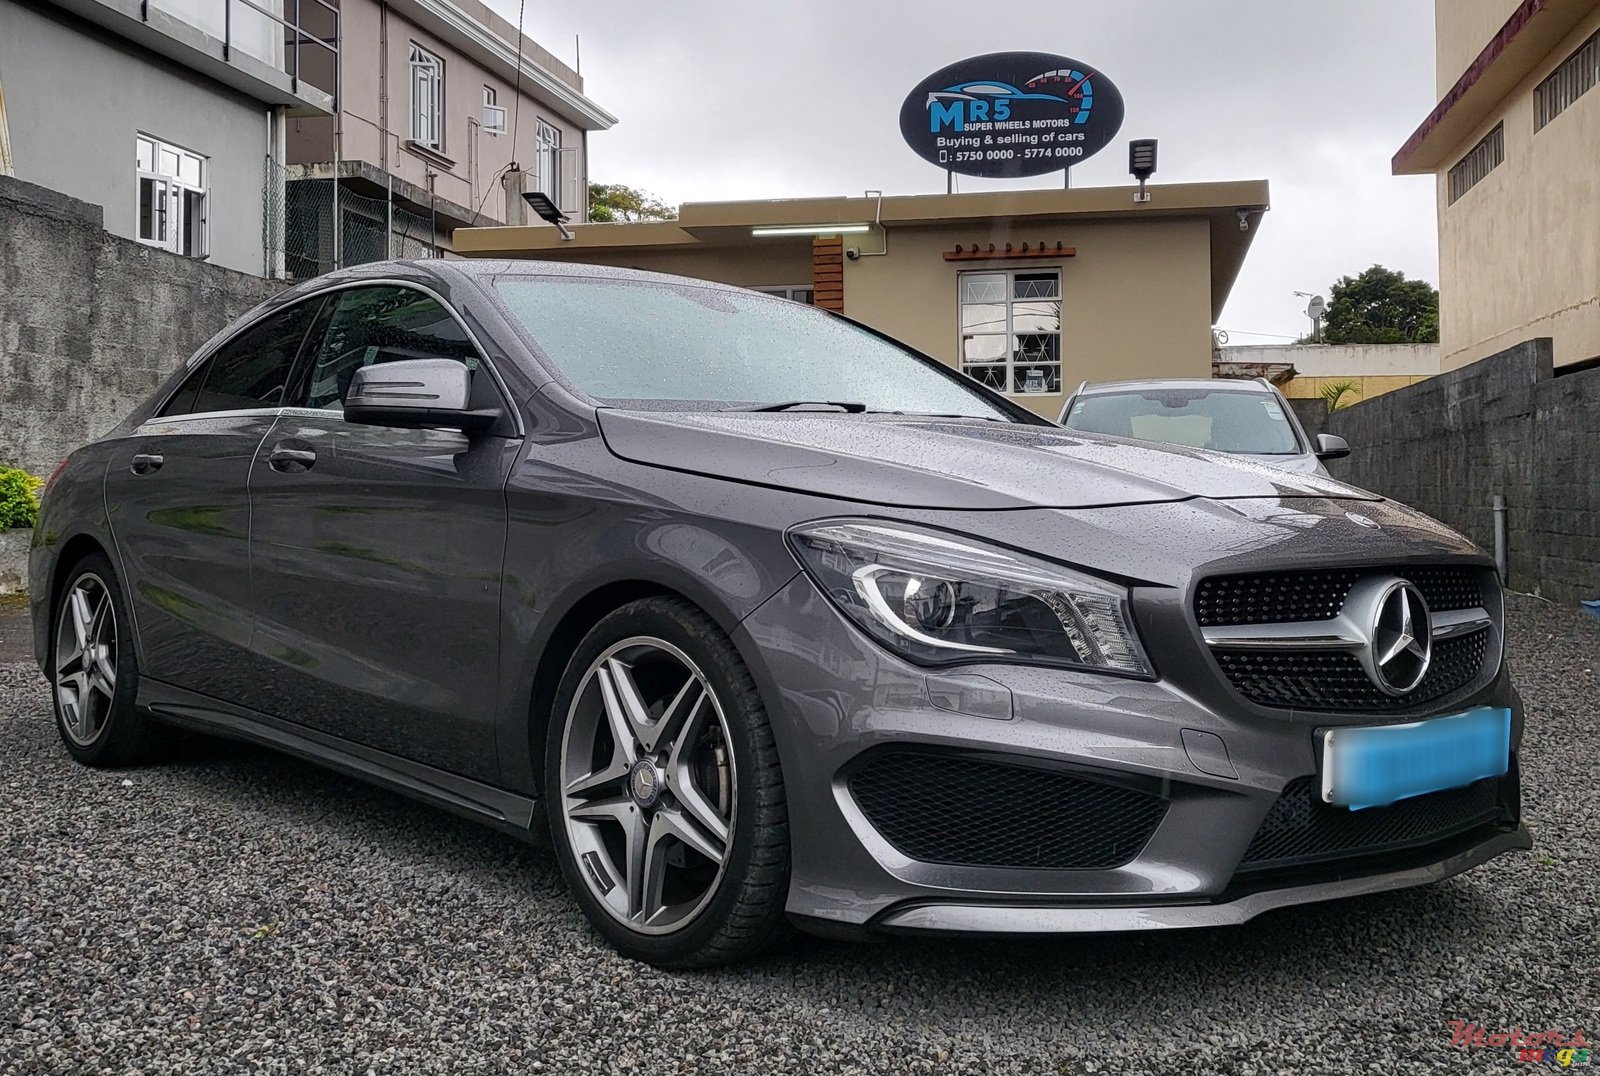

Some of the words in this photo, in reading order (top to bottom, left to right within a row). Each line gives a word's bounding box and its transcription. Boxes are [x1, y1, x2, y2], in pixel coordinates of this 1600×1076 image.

[964, 122, 993, 132] SUPER
[995, 121, 1030, 130] WHEELS
[1033, 119, 1070, 128] MOTORS
[937, 136, 981, 148] Buying
[984, 135, 993, 144] &
[997, 133, 1038, 145] selling
[1042, 132, 1056, 142] of
[1057, 132, 1085, 142] cars
[956, 151, 983, 161] 5750
[986, 150, 1014, 160] 0000
[1024, 148, 1052, 158] 5774
[1055, 147, 1083, 157] 0000
